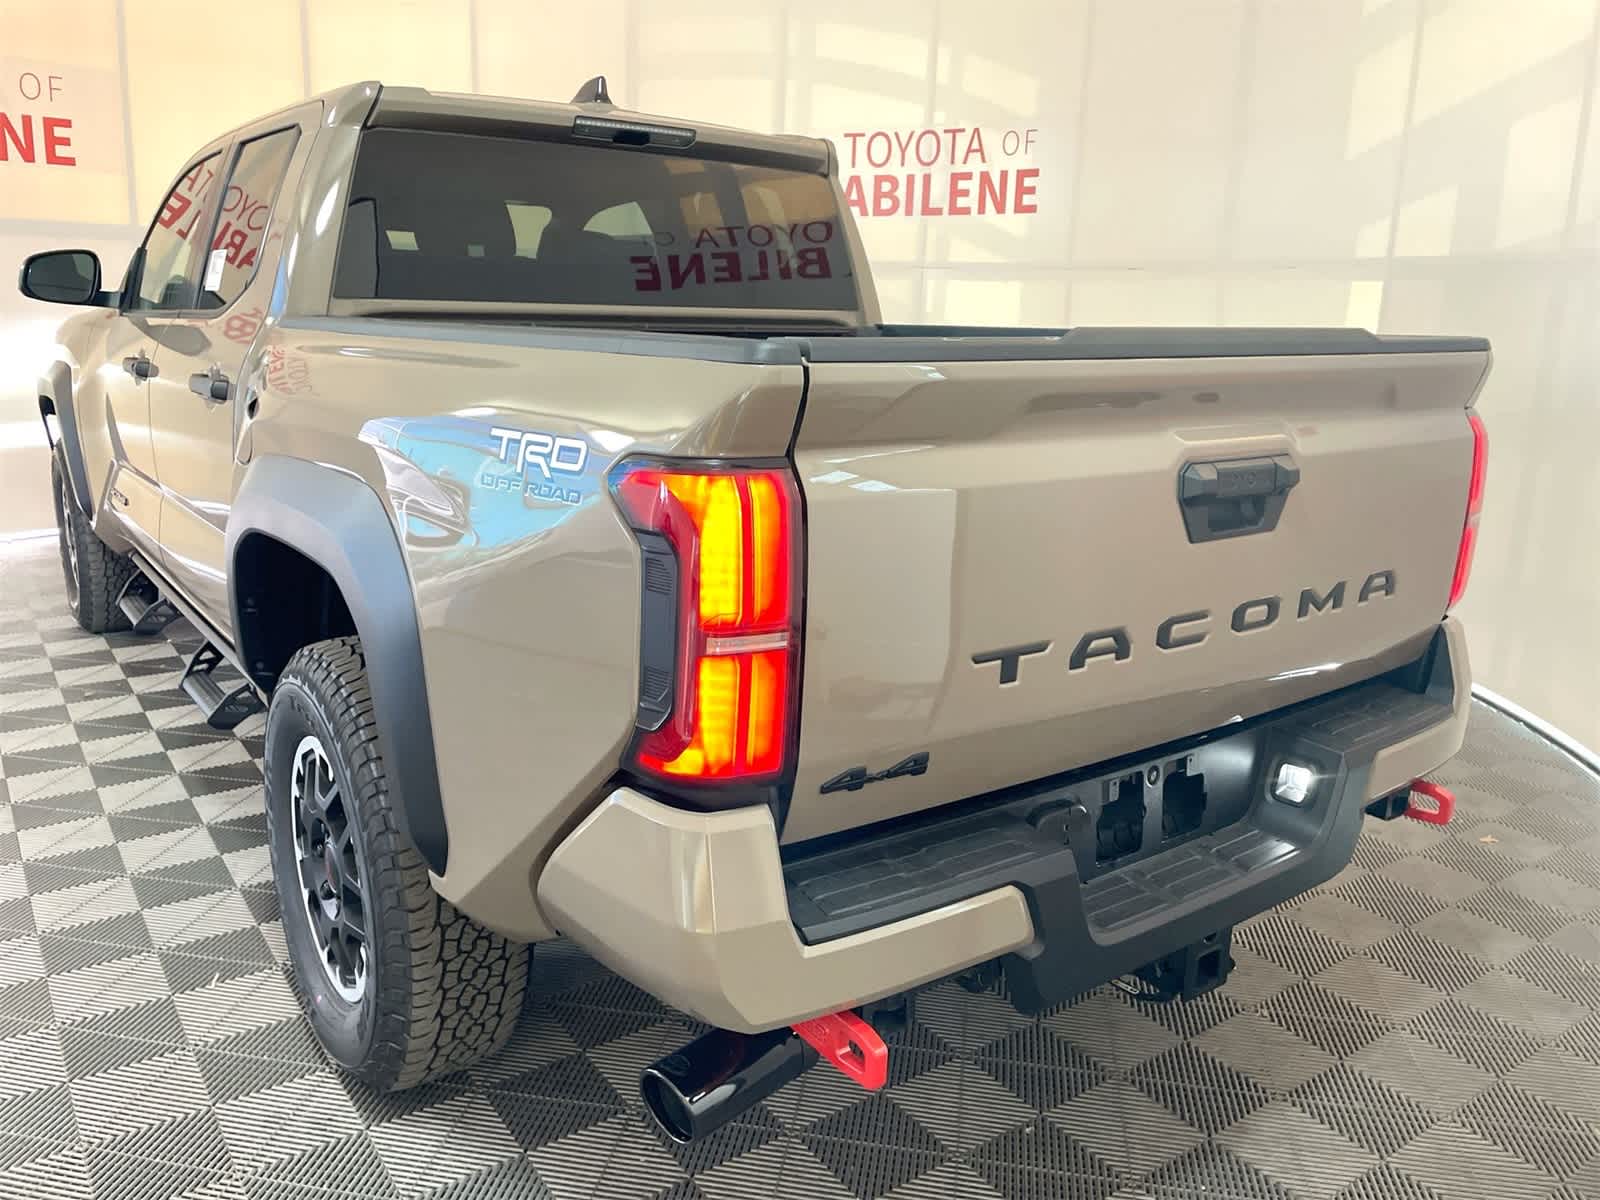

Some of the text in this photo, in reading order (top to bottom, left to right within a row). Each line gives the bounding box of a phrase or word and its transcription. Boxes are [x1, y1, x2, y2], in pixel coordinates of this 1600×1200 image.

[19, 72, 63, 102] OF
[844, 127, 1039, 169] TOYOTA OF
[844, 168, 1040, 217] ABILENE
[490, 427, 588, 480] TRD
[480, 472, 583, 506] OFF ROAD
[971, 569, 1396, 686] TACOMA
